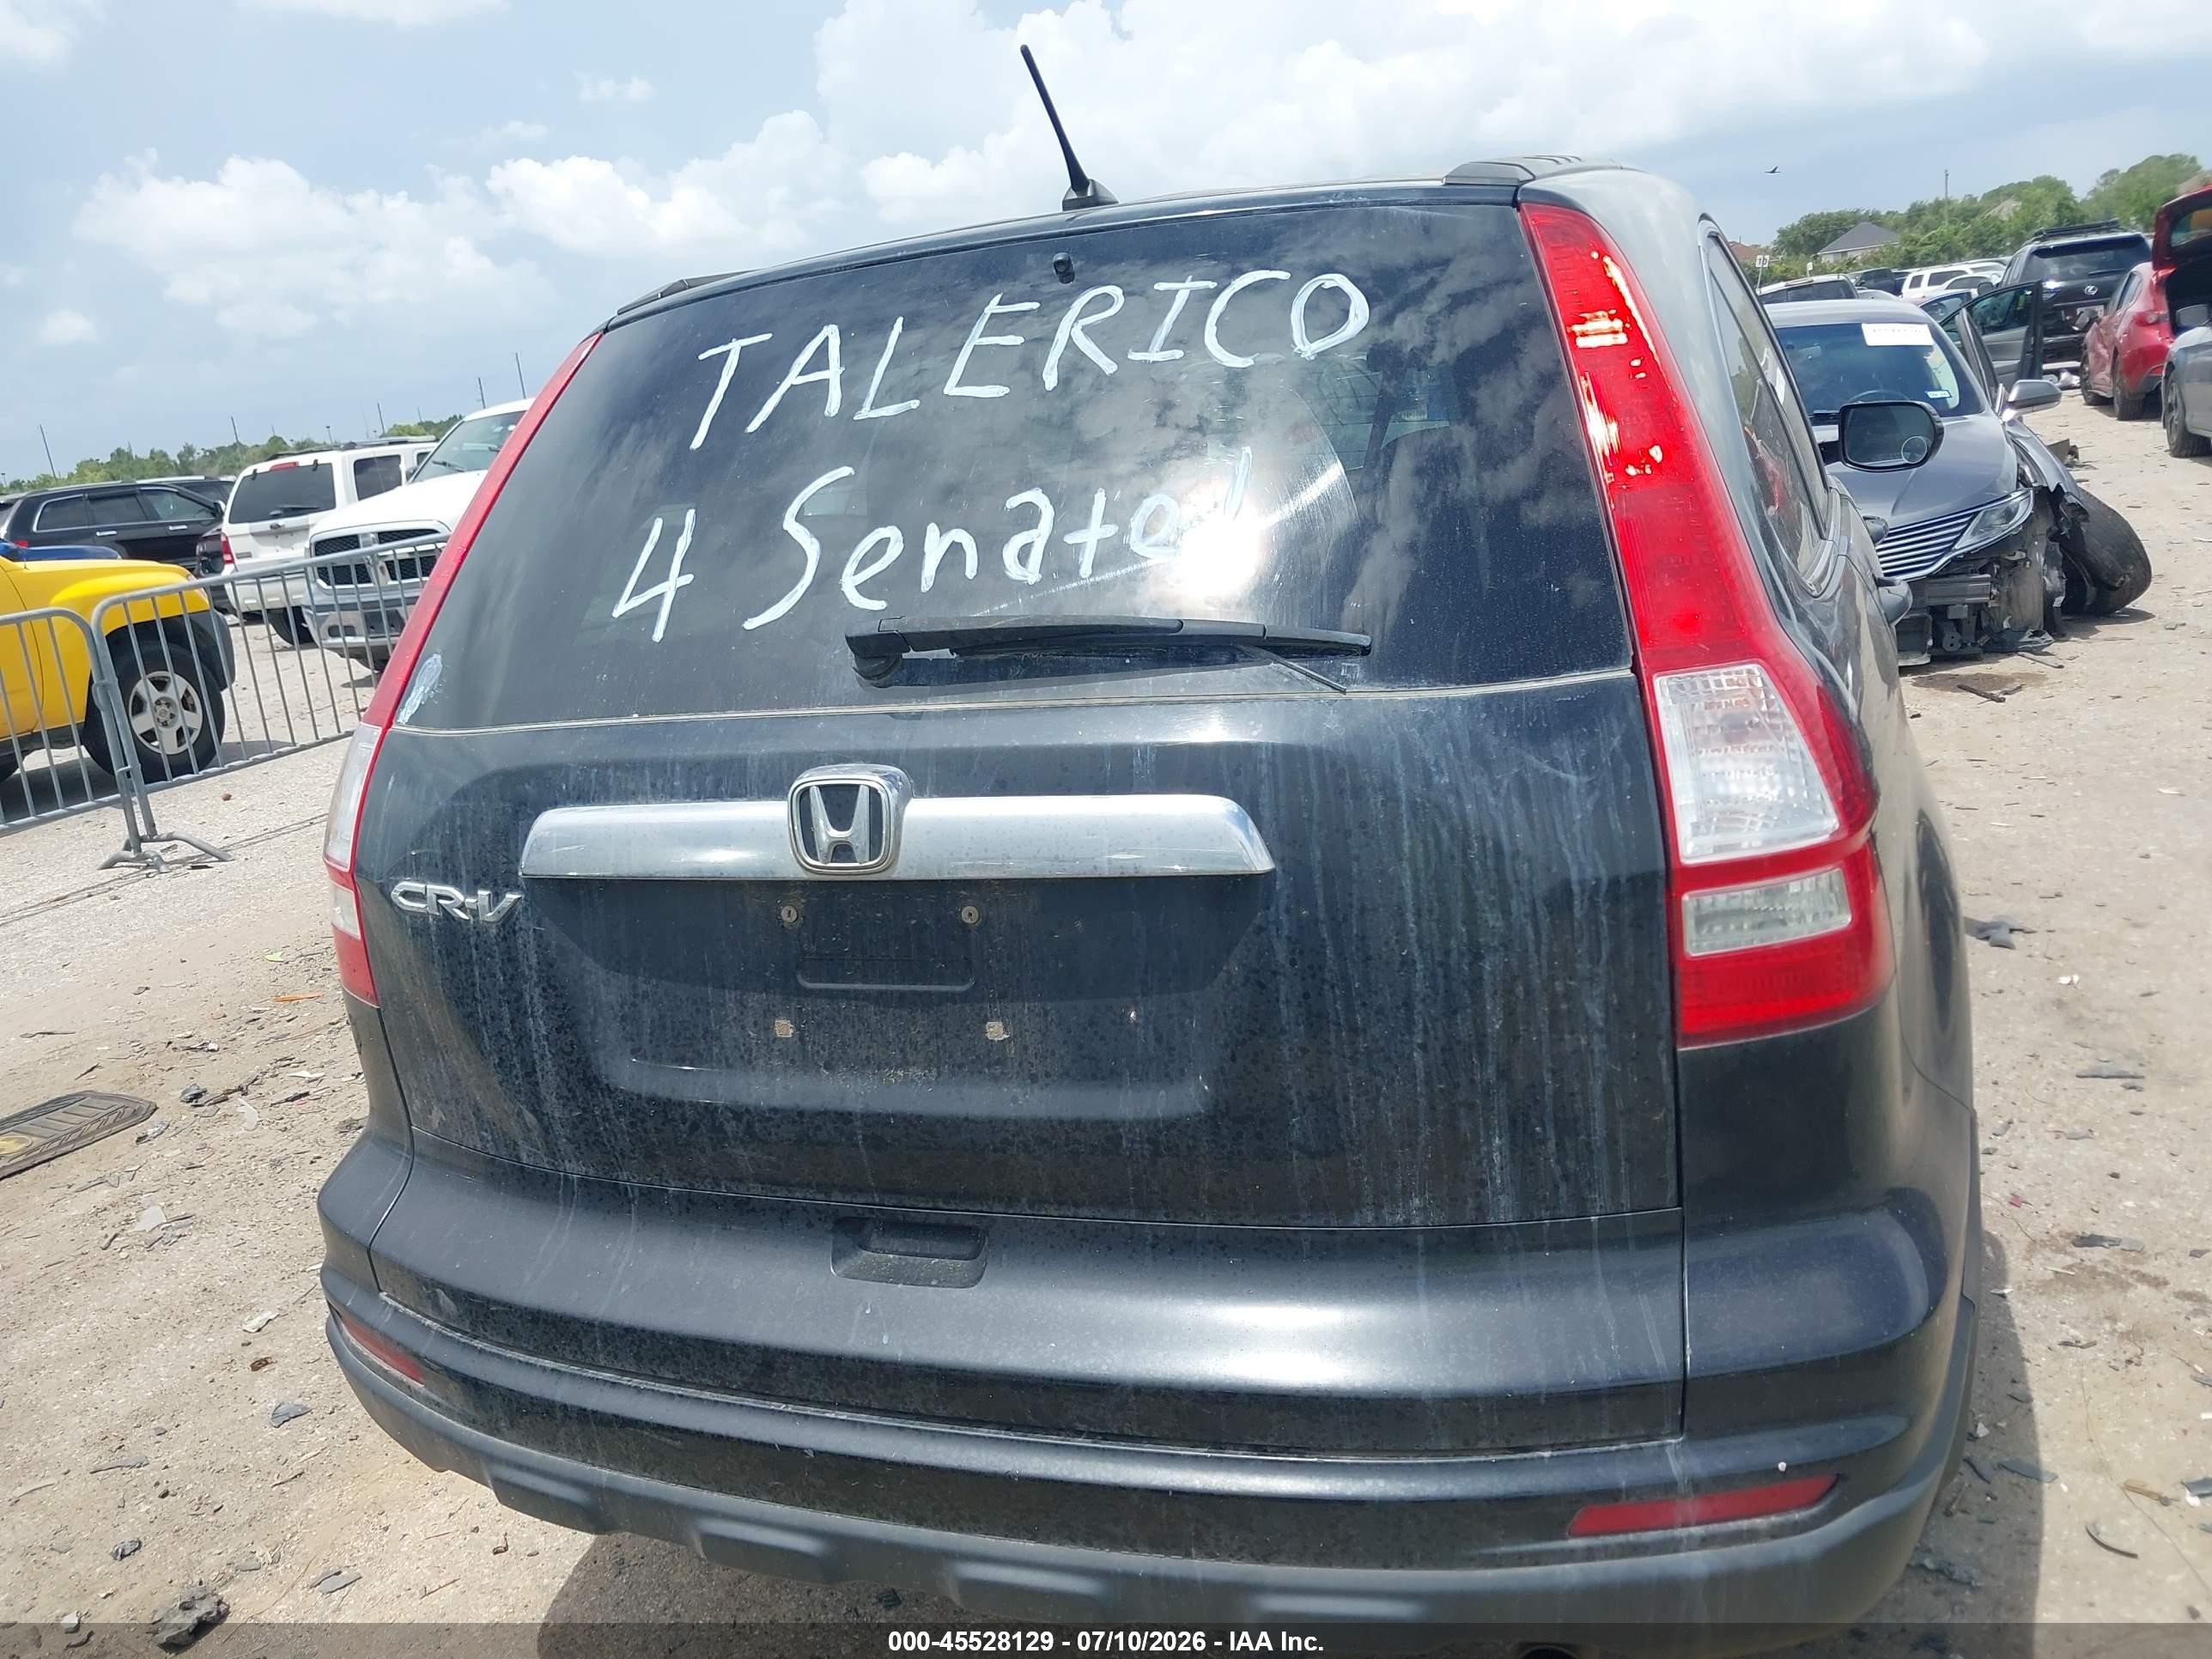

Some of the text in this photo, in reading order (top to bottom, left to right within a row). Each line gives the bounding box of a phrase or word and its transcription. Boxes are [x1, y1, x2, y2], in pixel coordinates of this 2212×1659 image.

[690, 270, 1370, 451] TALERICO
[611, 508, 696, 643] 4
[391, 881, 523, 923] CR-V
